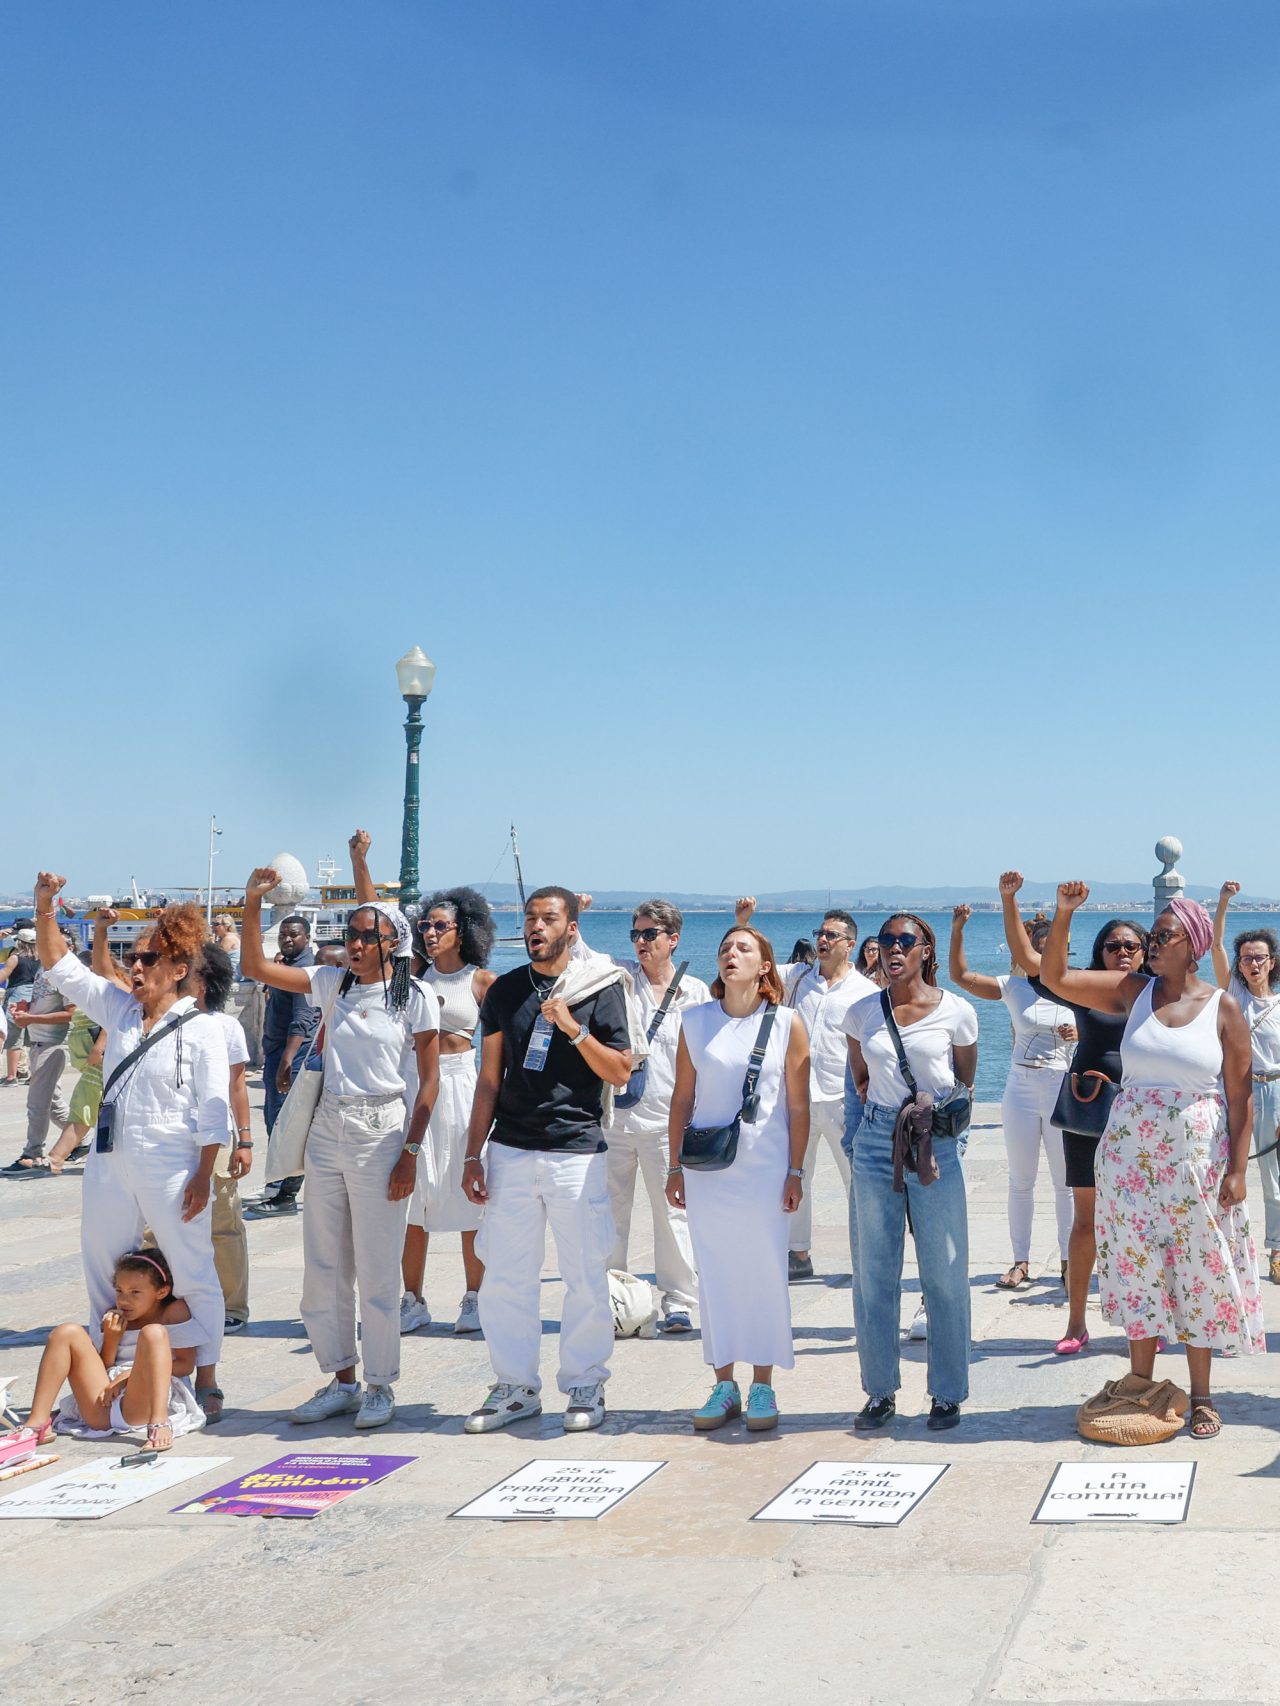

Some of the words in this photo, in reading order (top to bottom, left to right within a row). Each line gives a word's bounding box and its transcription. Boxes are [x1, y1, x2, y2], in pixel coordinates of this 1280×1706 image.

[590, 1467, 617, 1475] de
[876, 1470, 902, 1478] de
[244, 1473, 307, 1482] #Eu
[540, 1476, 605, 1484] ABRIL
[239, 1477, 370, 1489] Também
[828, 1479, 894, 1488] ABRIL
[1084, 1482, 1146, 1490] LUTA
[499, 1485, 560, 1493] PARA
[570, 1486, 626, 1494] TODA
[791, 1488, 851, 1496] PARA
[860, 1490, 916, 1499] TODA
[523, 1496, 607, 1504] GENTE!
[1050, 1492, 1184, 1501] CONTINUA!
[819, 1499, 900, 1508] GENTE!
